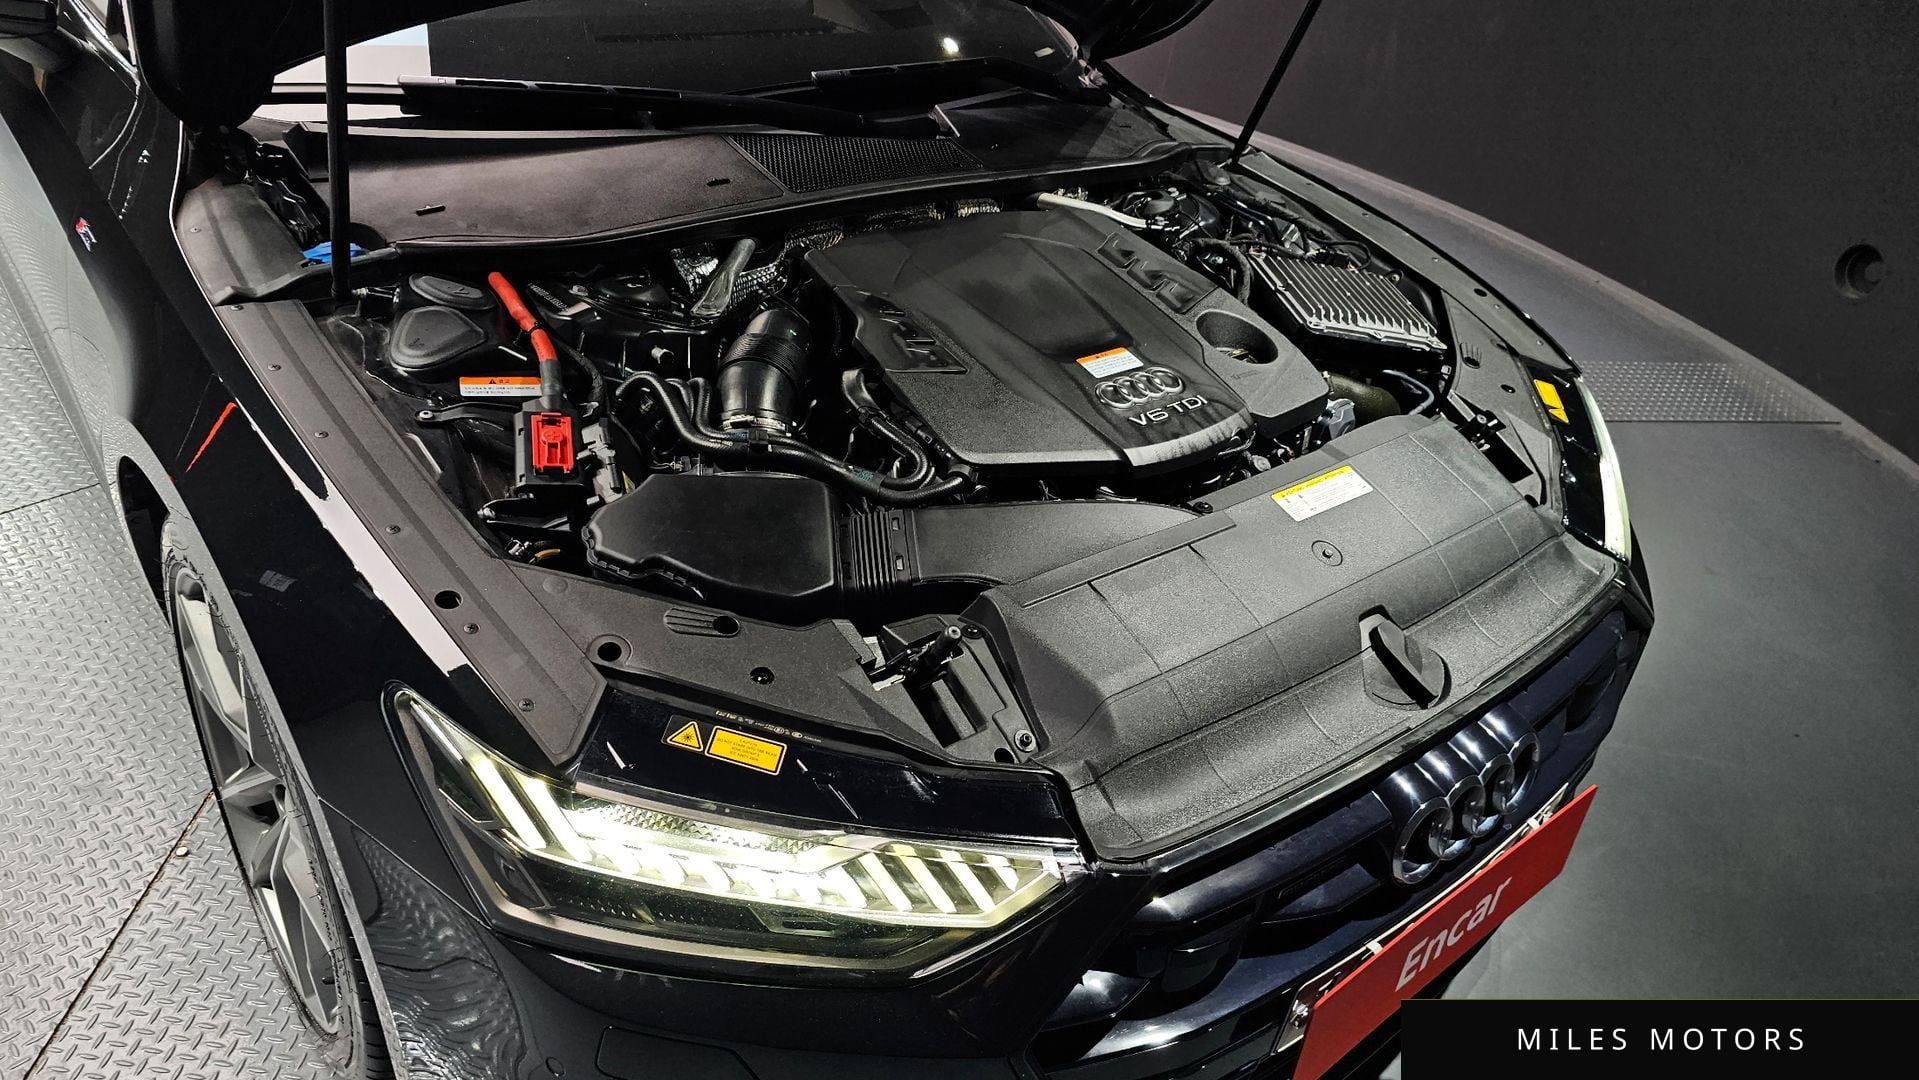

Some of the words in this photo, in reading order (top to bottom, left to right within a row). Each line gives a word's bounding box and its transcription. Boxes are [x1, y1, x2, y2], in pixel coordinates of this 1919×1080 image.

[1129, 407, 1169, 427] V6
[1166, 394, 1208, 413] TDI
[1395, 876, 1513, 993] Encar
